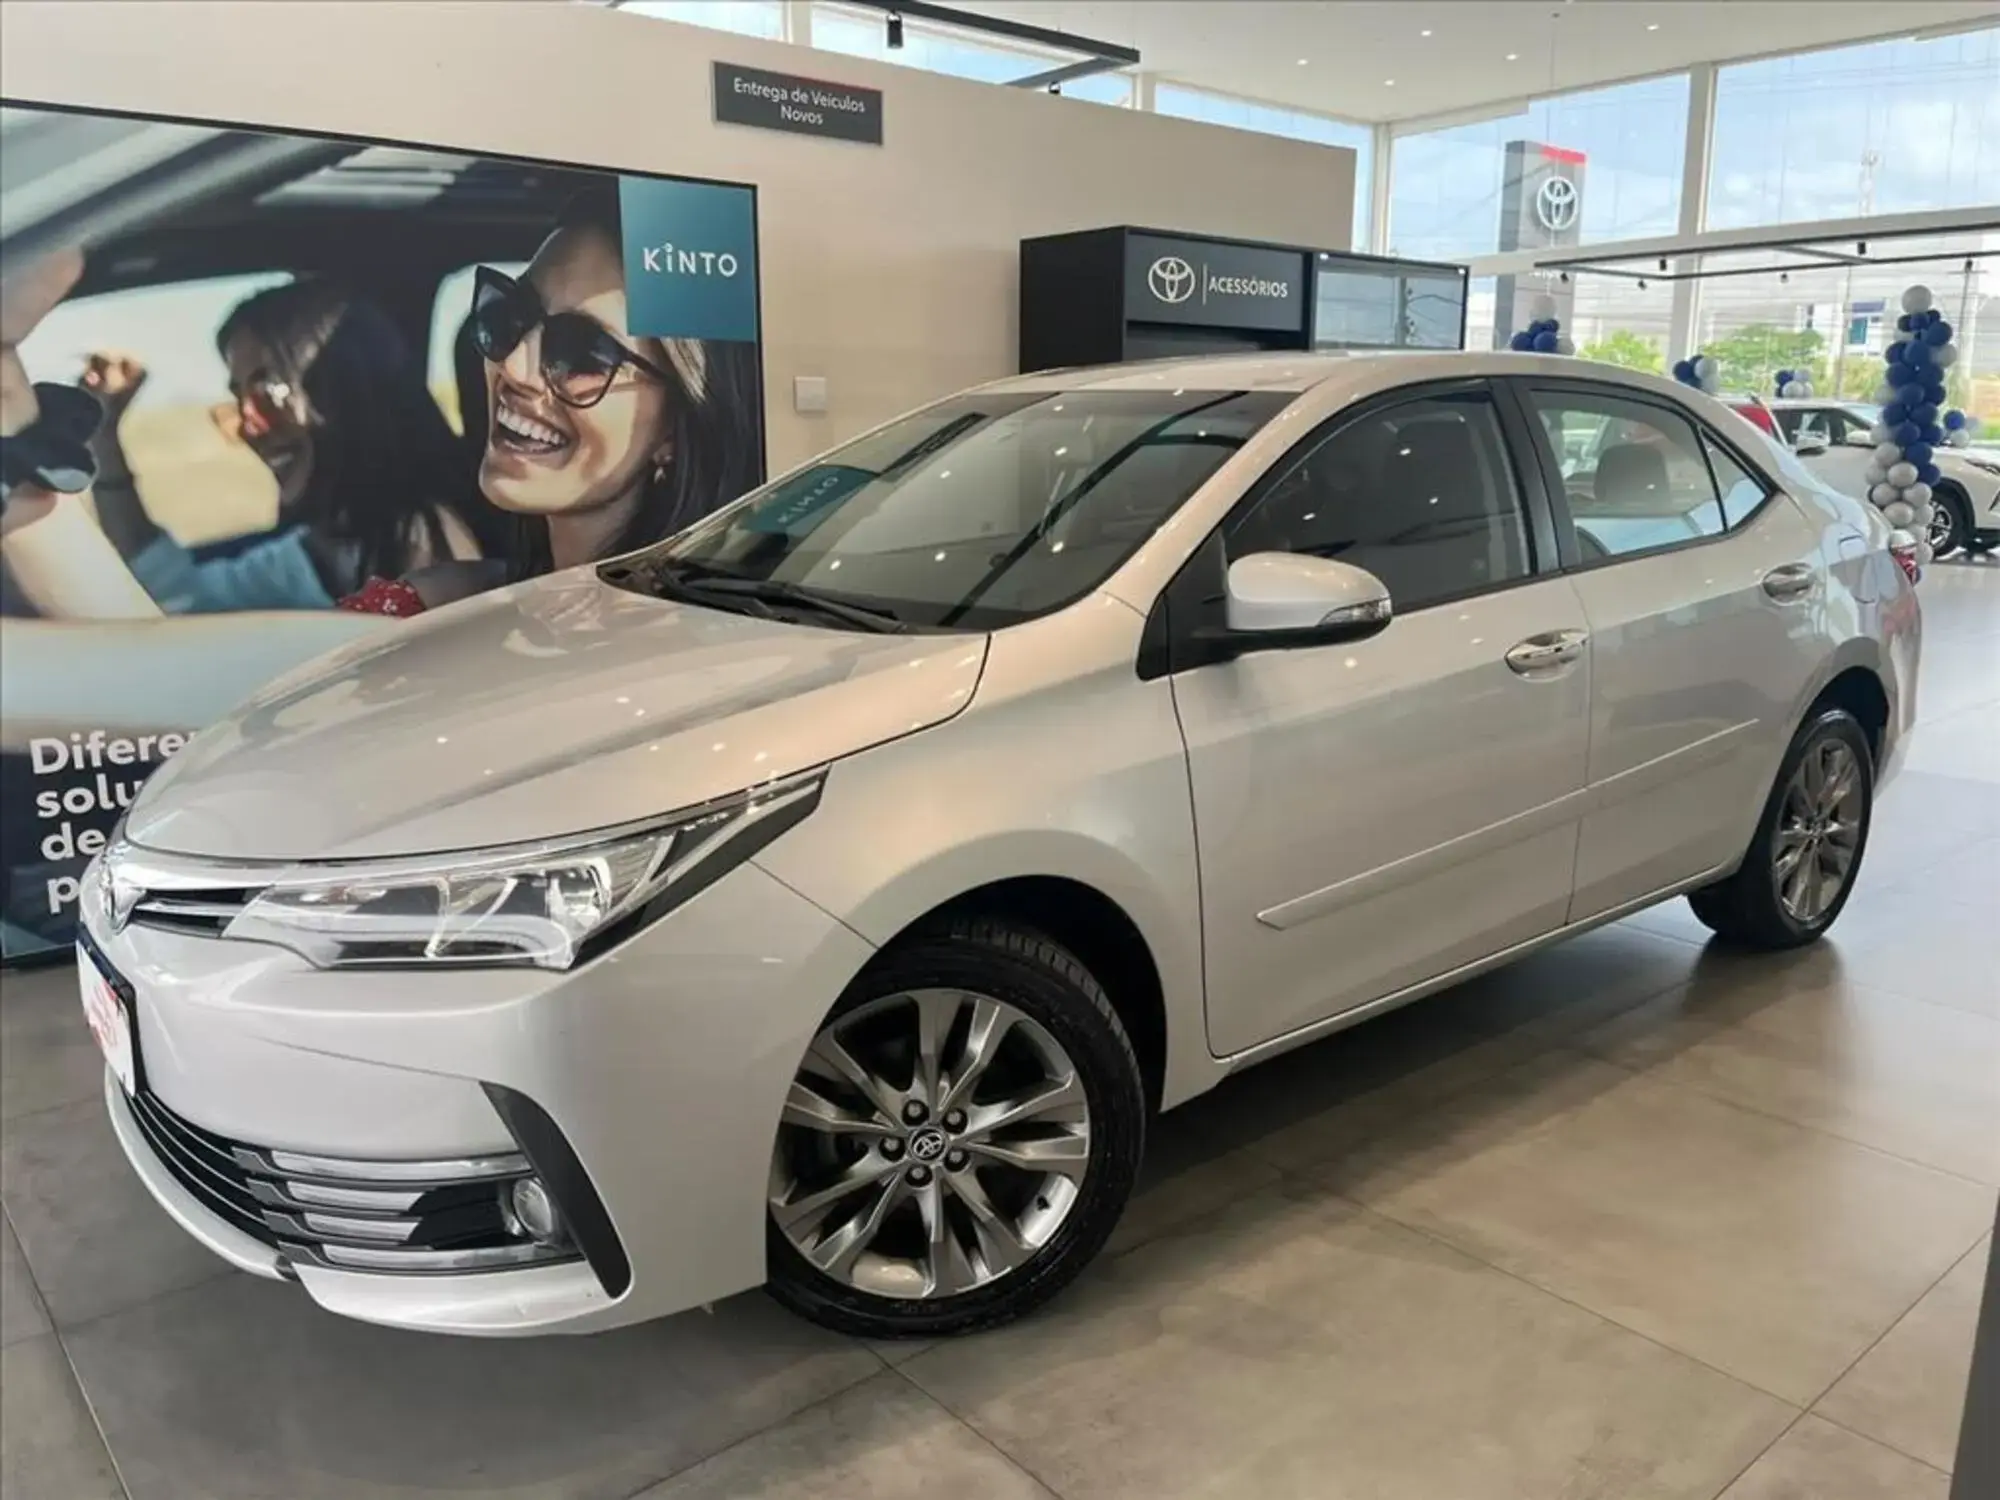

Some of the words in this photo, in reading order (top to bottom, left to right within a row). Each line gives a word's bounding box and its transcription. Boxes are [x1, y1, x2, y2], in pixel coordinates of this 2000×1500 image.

[734, 77, 788, 102] Entrega
[791, 87, 808, 104] de
[811, 90, 866, 112] Veículos
[781, 105, 823, 125] Novos
[1208, 275, 1288, 298] ACESSÓRIOS
[41, 822, 107, 861] de
